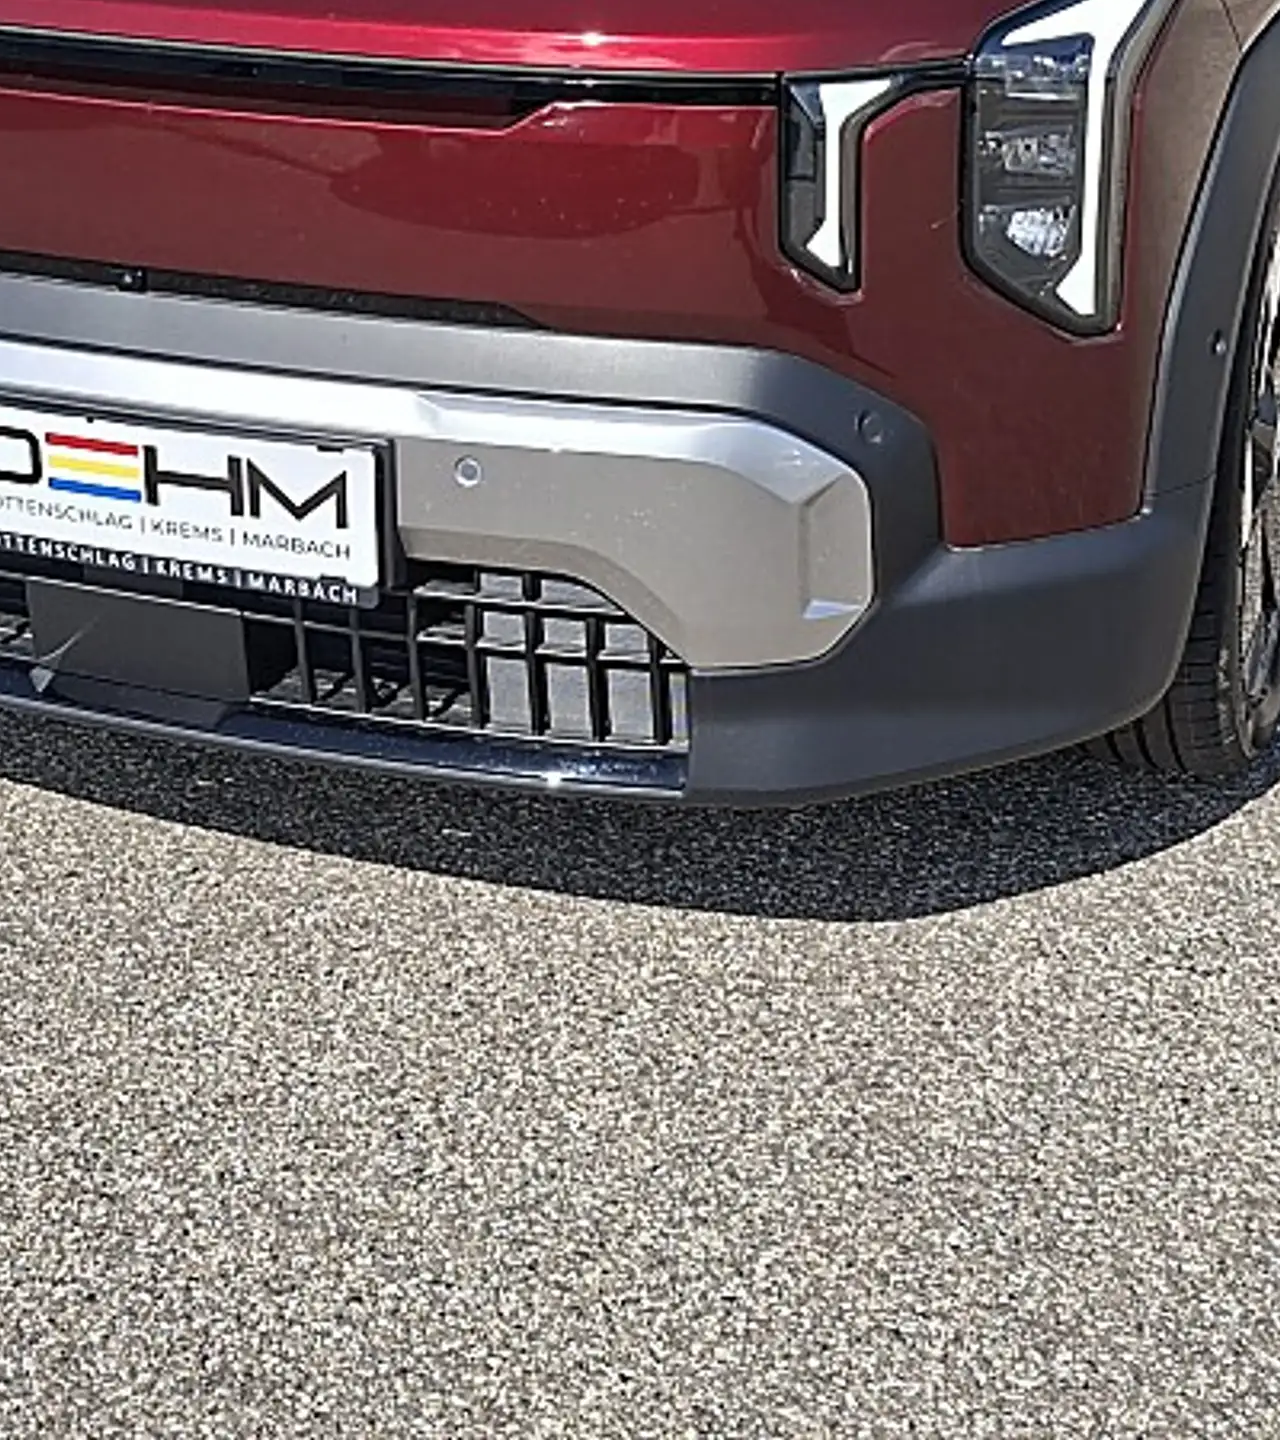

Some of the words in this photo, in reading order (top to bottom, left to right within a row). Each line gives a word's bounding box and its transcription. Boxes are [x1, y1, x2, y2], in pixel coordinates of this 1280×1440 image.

[151, 517, 223, 543] KREMS
[242, 530, 351, 560] MARBACH
[155, 559, 228, 585] KREMS
[248, 572, 358, 605] MARBACH
